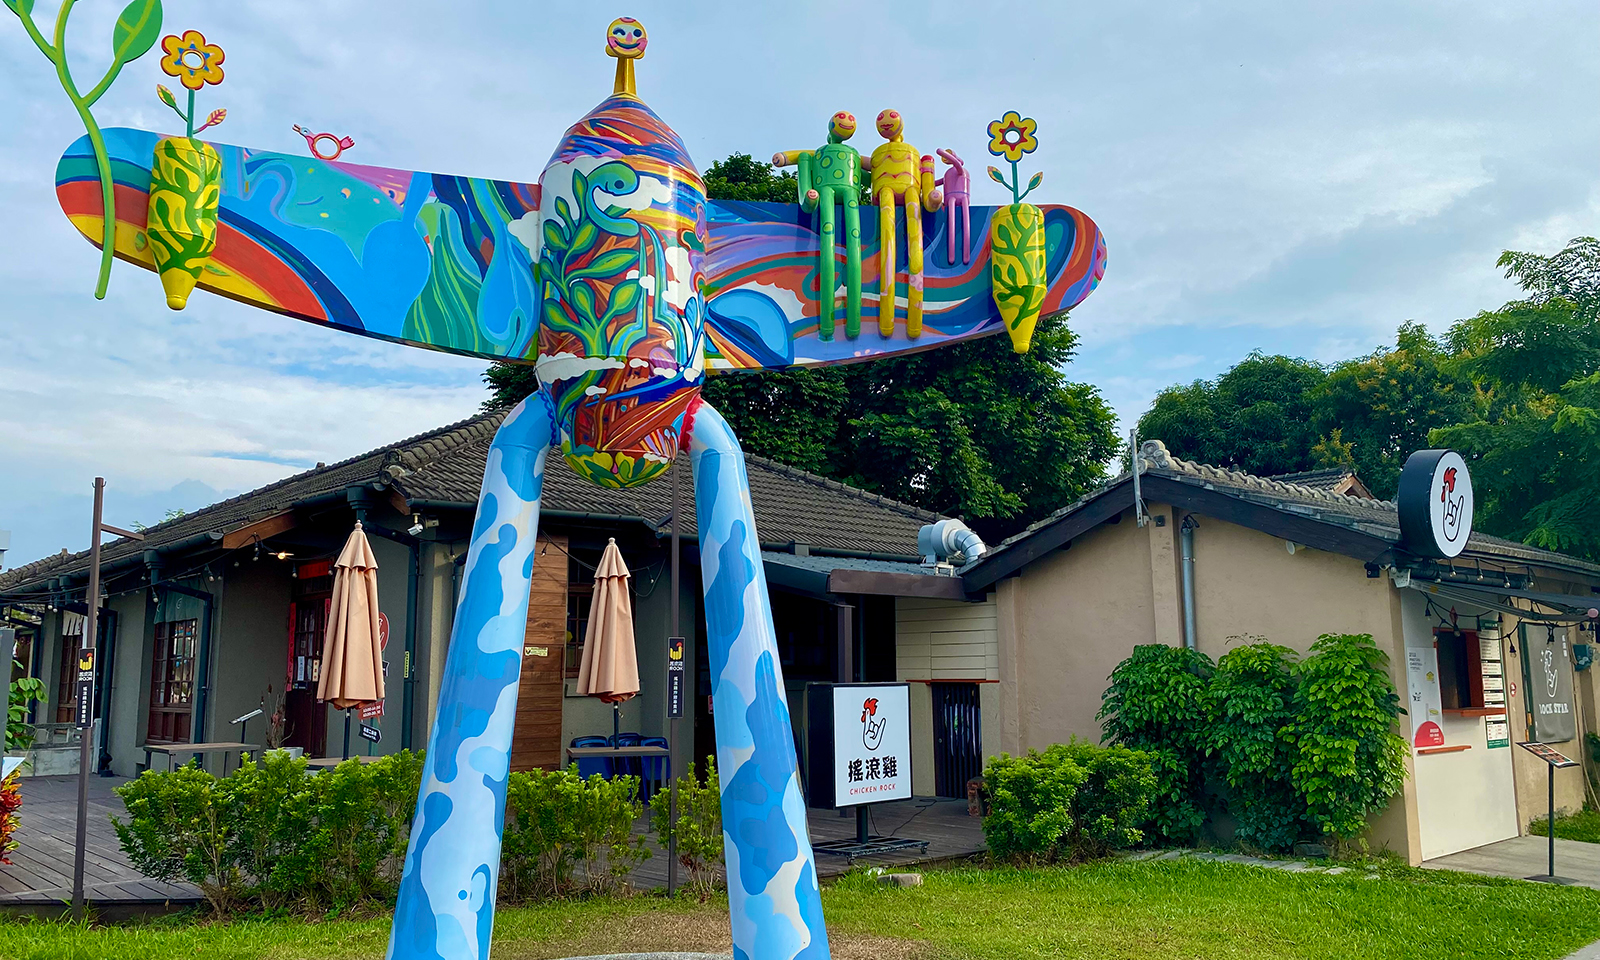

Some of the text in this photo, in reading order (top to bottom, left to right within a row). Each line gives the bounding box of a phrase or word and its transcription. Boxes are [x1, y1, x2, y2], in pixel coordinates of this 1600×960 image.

[848, 755, 898, 783] 搖滾雞
[849, 783, 896, 795] CHICKEN ROCK
